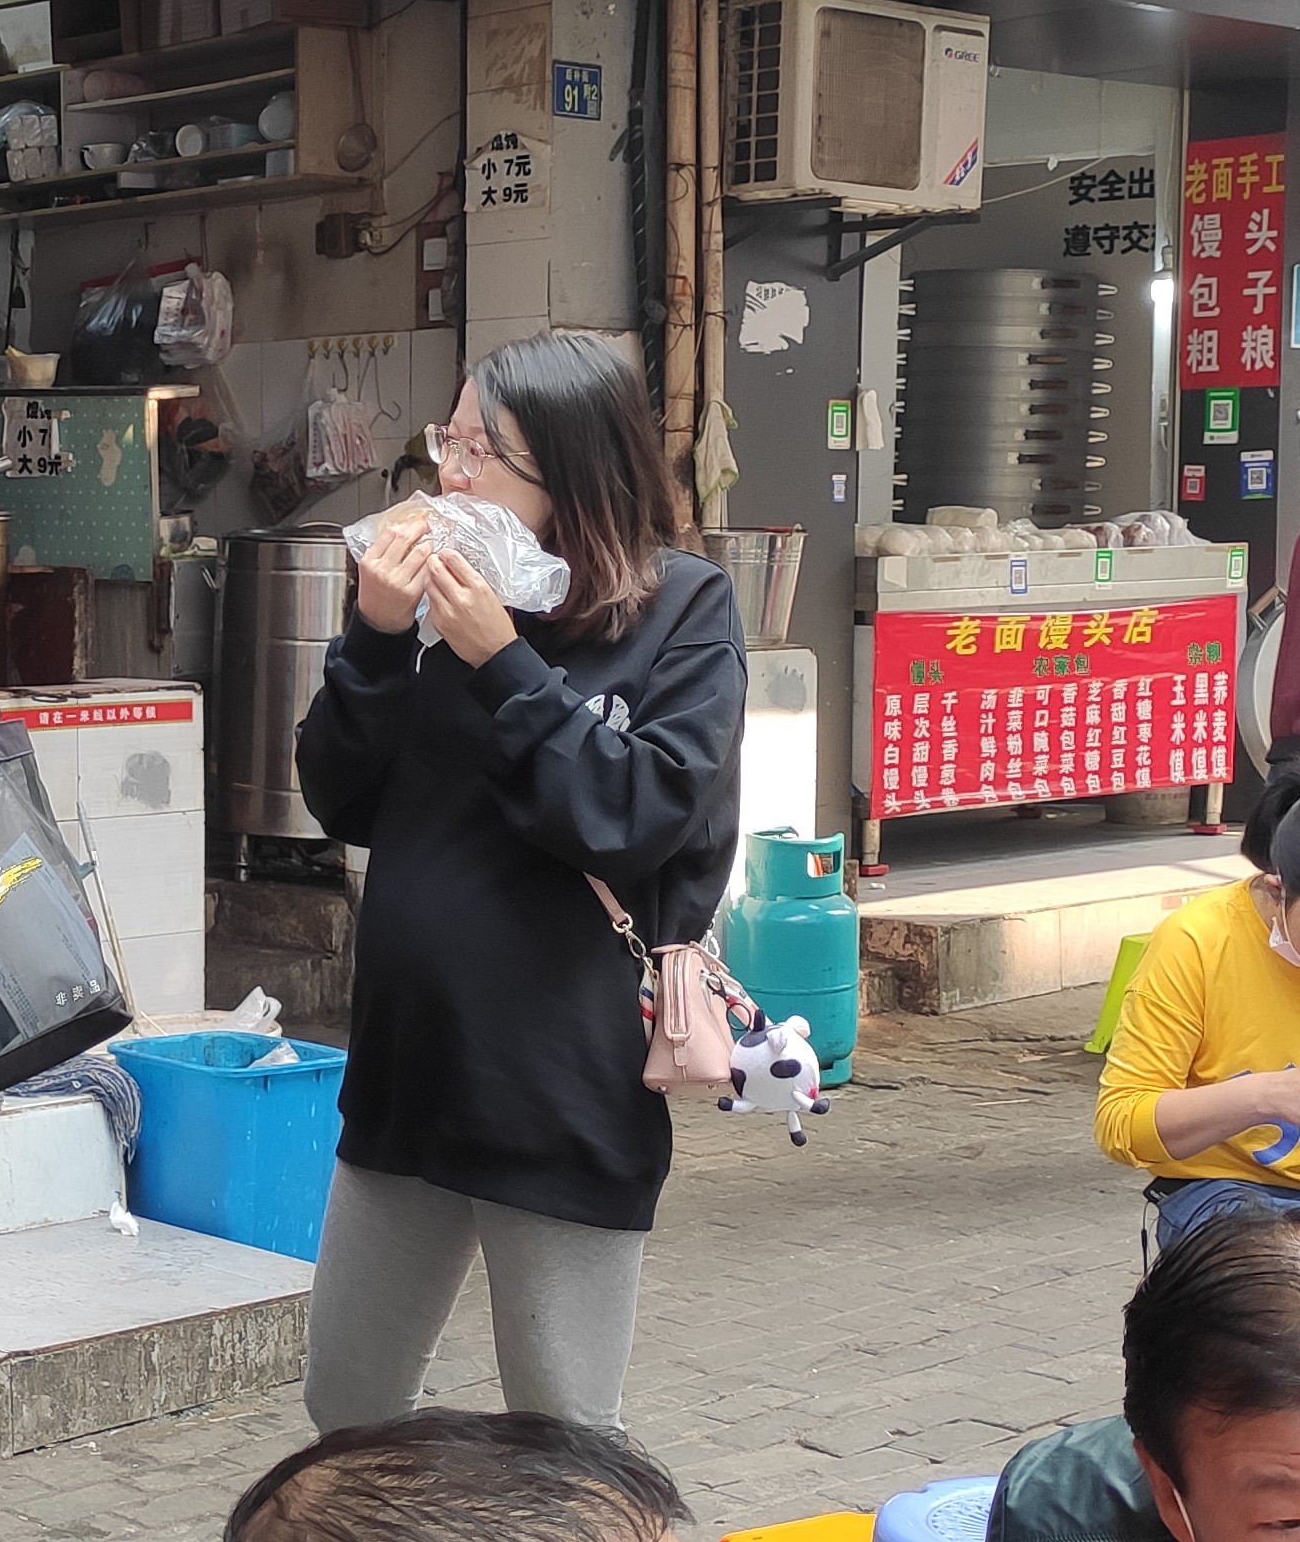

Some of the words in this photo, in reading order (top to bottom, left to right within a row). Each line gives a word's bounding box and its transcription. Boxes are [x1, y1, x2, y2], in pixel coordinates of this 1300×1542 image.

[954, 50, 980, 63] GREE
[564, 84, 579, 112] 91
[481, 158, 497, 180] 小
[503, 154, 532, 177] 7元
[1185, 152, 1286, 204] 老面手工
[481, 186, 498, 206] 大
[502, 182, 529, 203] 9元
[1062, 220, 1157, 258] 遵守交
[1190, 208, 1279, 259] 馒头
[1189, 270, 1278, 319] 包子
[1186, 324, 1276, 374] 粗粮
[17, 424, 34, 448] 小
[17, 453, 33, 475] 大
[945, 607, 1159, 656] 老面馒头店
[910, 659, 944, 686] 馒头
[883, 694, 903, 815] 原味白馒头
[911, 692, 932, 811] 层次甜馒头
[977, 688, 999, 804] 汤汁鲜肉包
[1004, 685, 1027, 802] 韭菜粉丝包
